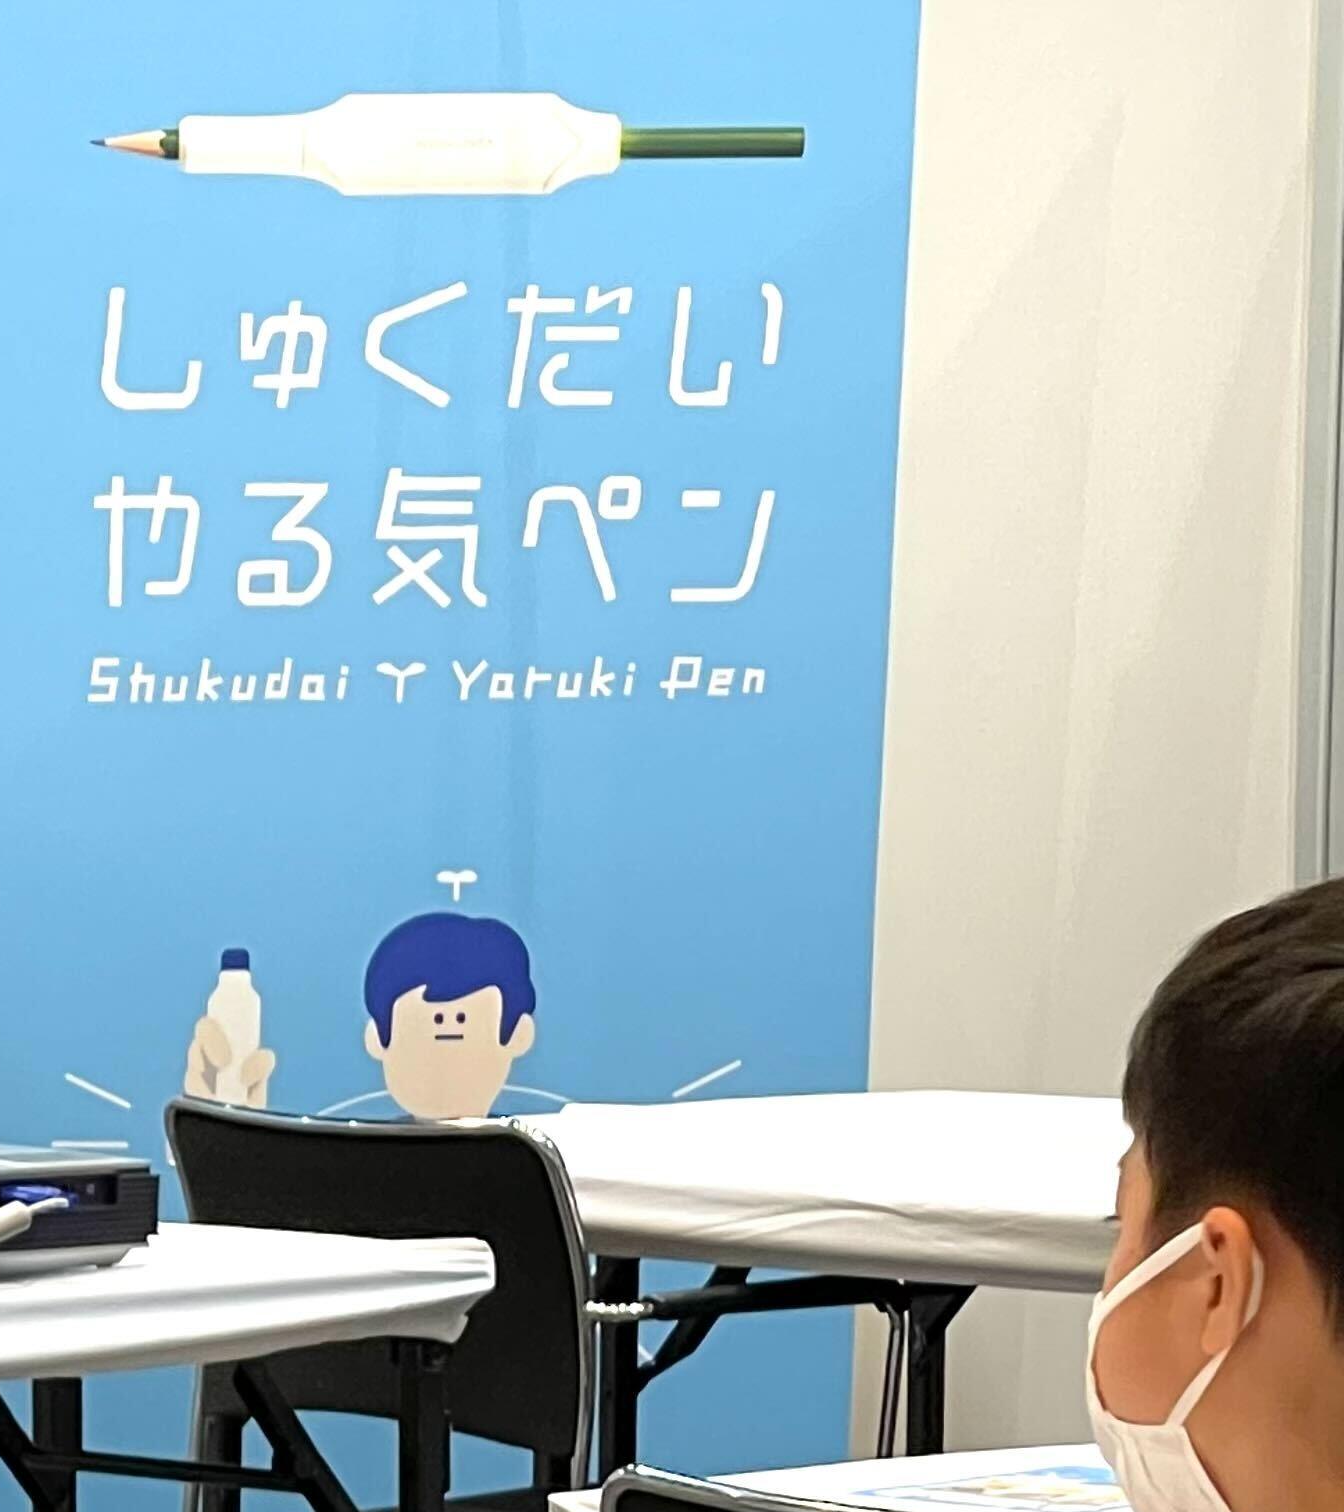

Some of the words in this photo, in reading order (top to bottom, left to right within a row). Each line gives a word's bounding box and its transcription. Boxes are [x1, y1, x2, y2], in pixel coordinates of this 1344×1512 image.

[98, 281, 785, 412] しゅくだい
[92, 466, 776, 609] やる気ペン
[86, 656, 350, 704] Shukudai
[451, 656, 637, 702] Yaruki
[658, 655, 767, 700] Pen
